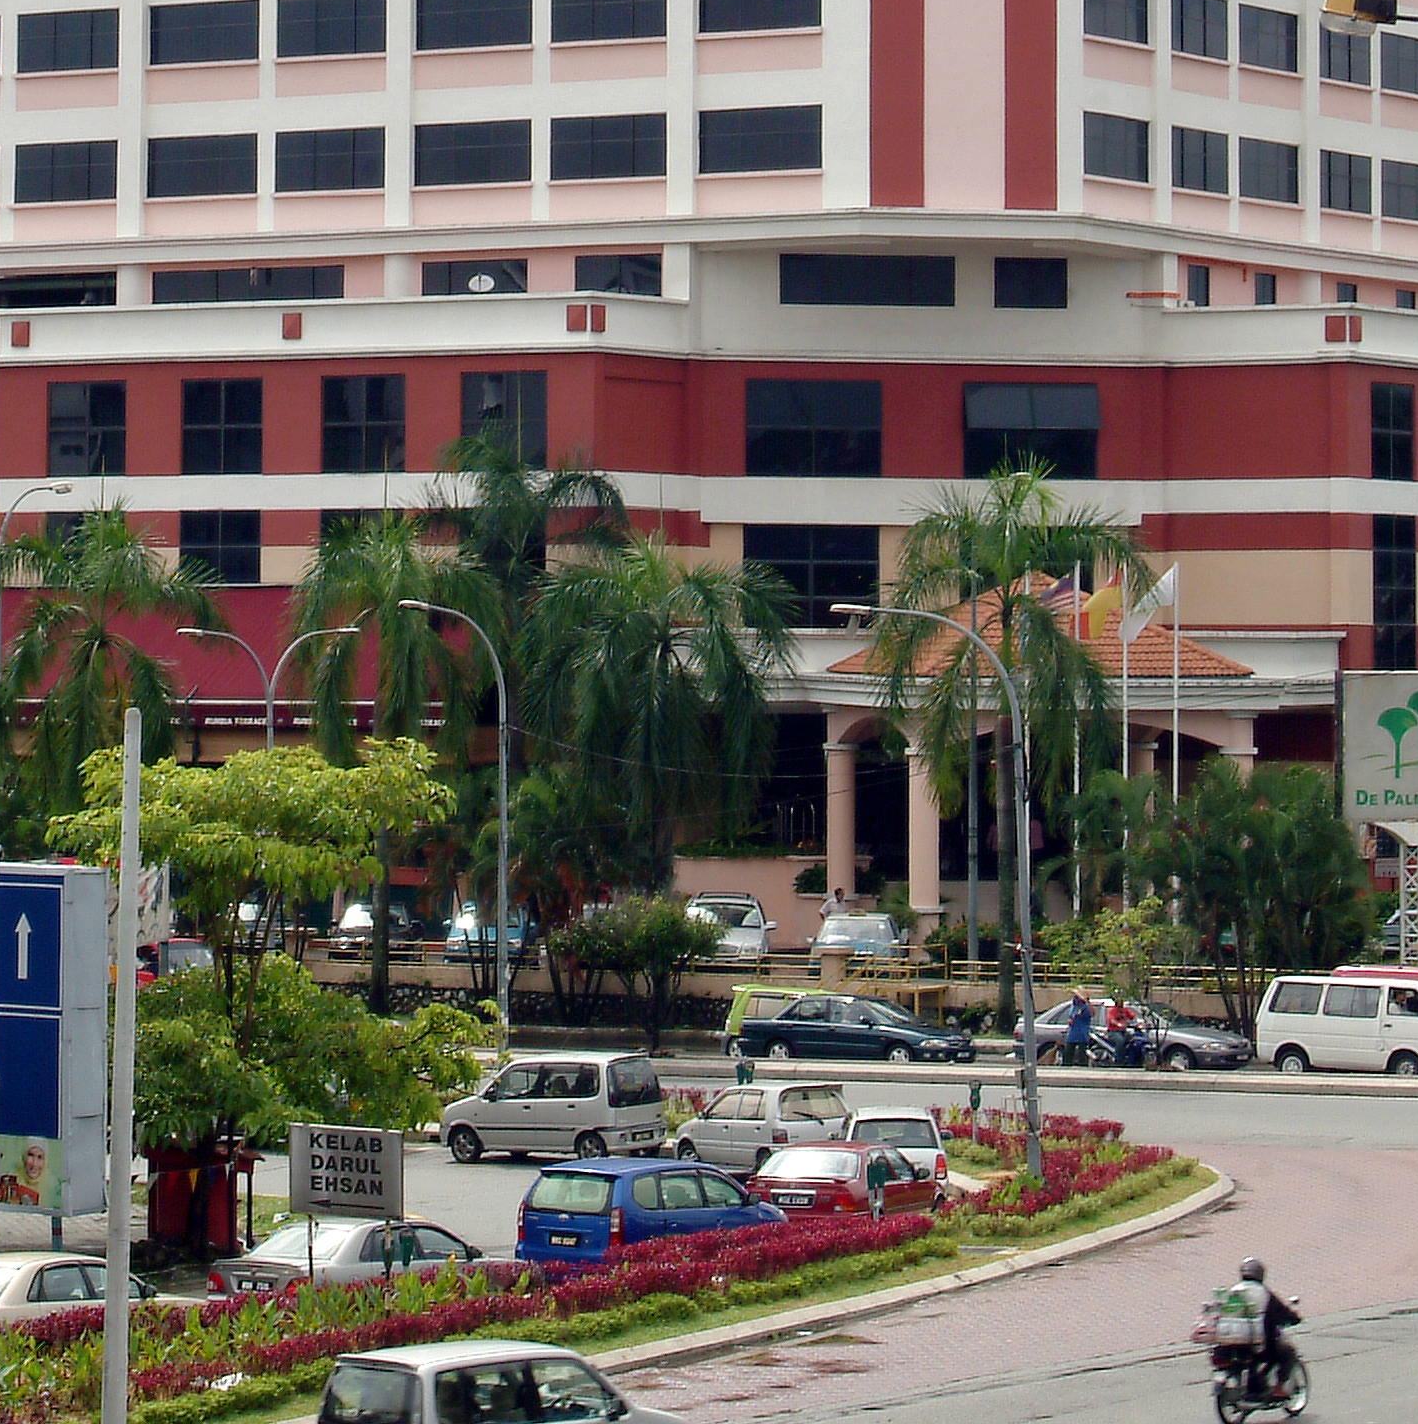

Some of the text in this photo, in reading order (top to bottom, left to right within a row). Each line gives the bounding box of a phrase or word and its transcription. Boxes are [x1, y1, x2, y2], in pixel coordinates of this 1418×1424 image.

[309, 1133, 383, 1153] KELAB
[311, 1154, 381, 1175] DARUL
[310, 1175, 383, 1196] EHSAN
